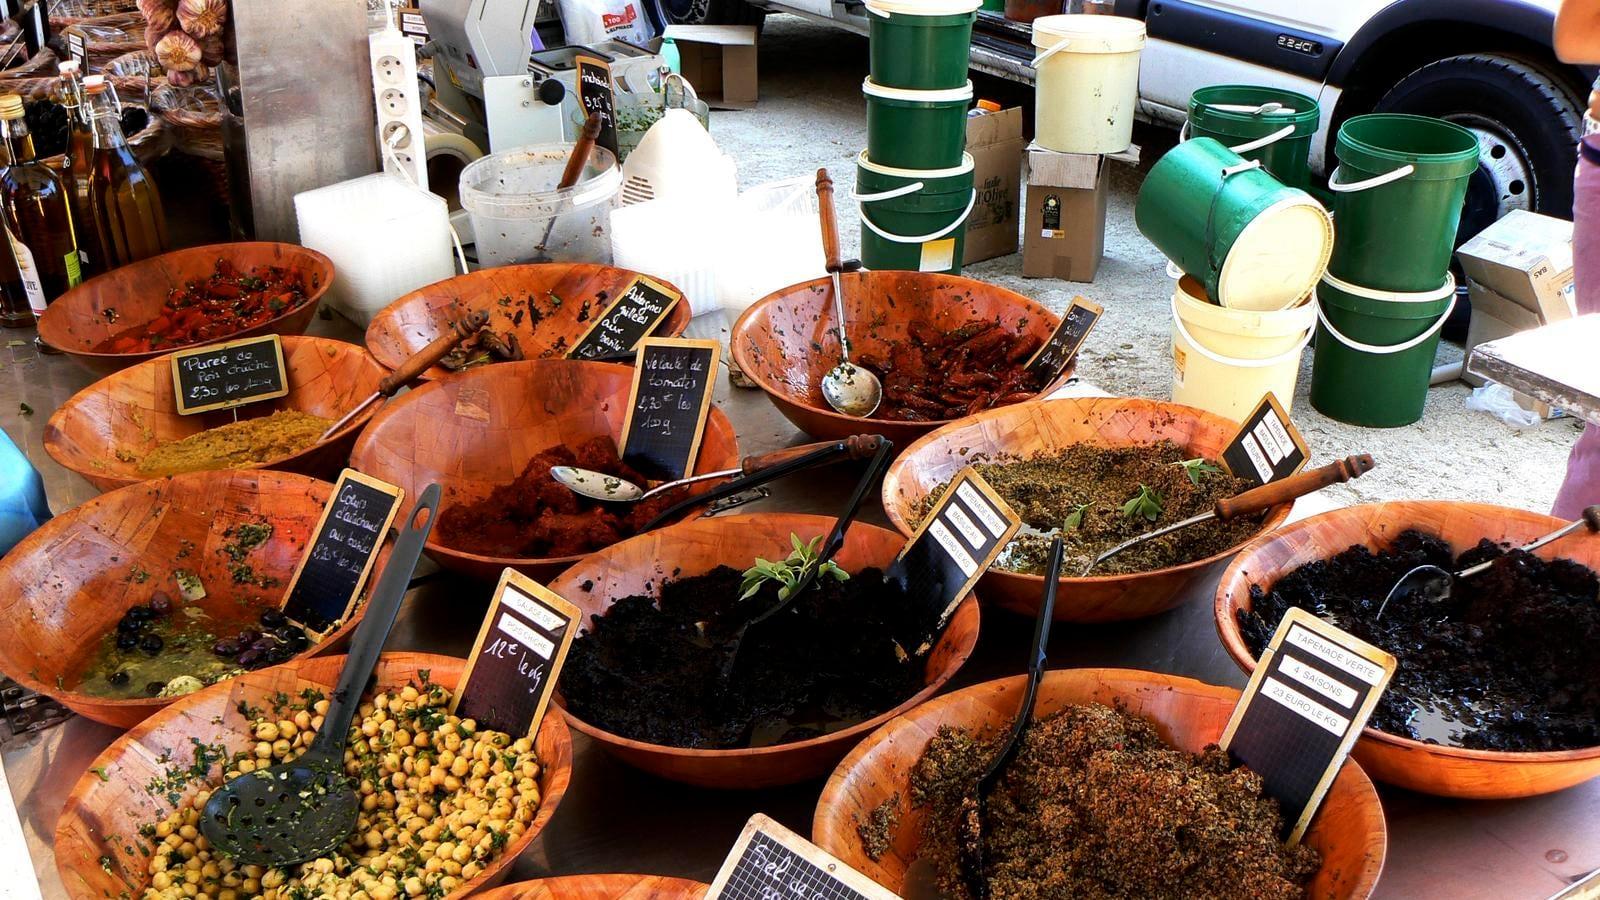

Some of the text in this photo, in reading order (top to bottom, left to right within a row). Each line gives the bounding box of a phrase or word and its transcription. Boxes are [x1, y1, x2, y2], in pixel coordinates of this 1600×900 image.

[1533, 266, 1548, 279] BAS
[601, 318, 625, 334] aux
[961, 487, 988, 517] TAPENADE
[935, 527, 943, 537] 23
[942, 534, 957, 552] EURO
[955, 549, 964, 560] LE
[1297, 632, 1376, 679] TAPENADE VERTE
[1293, 666, 1343, 697] 4 SAISONS
[1272, 686, 1339, 728] 23 EURO LE KG
[753, 844, 792, 881] Sel
